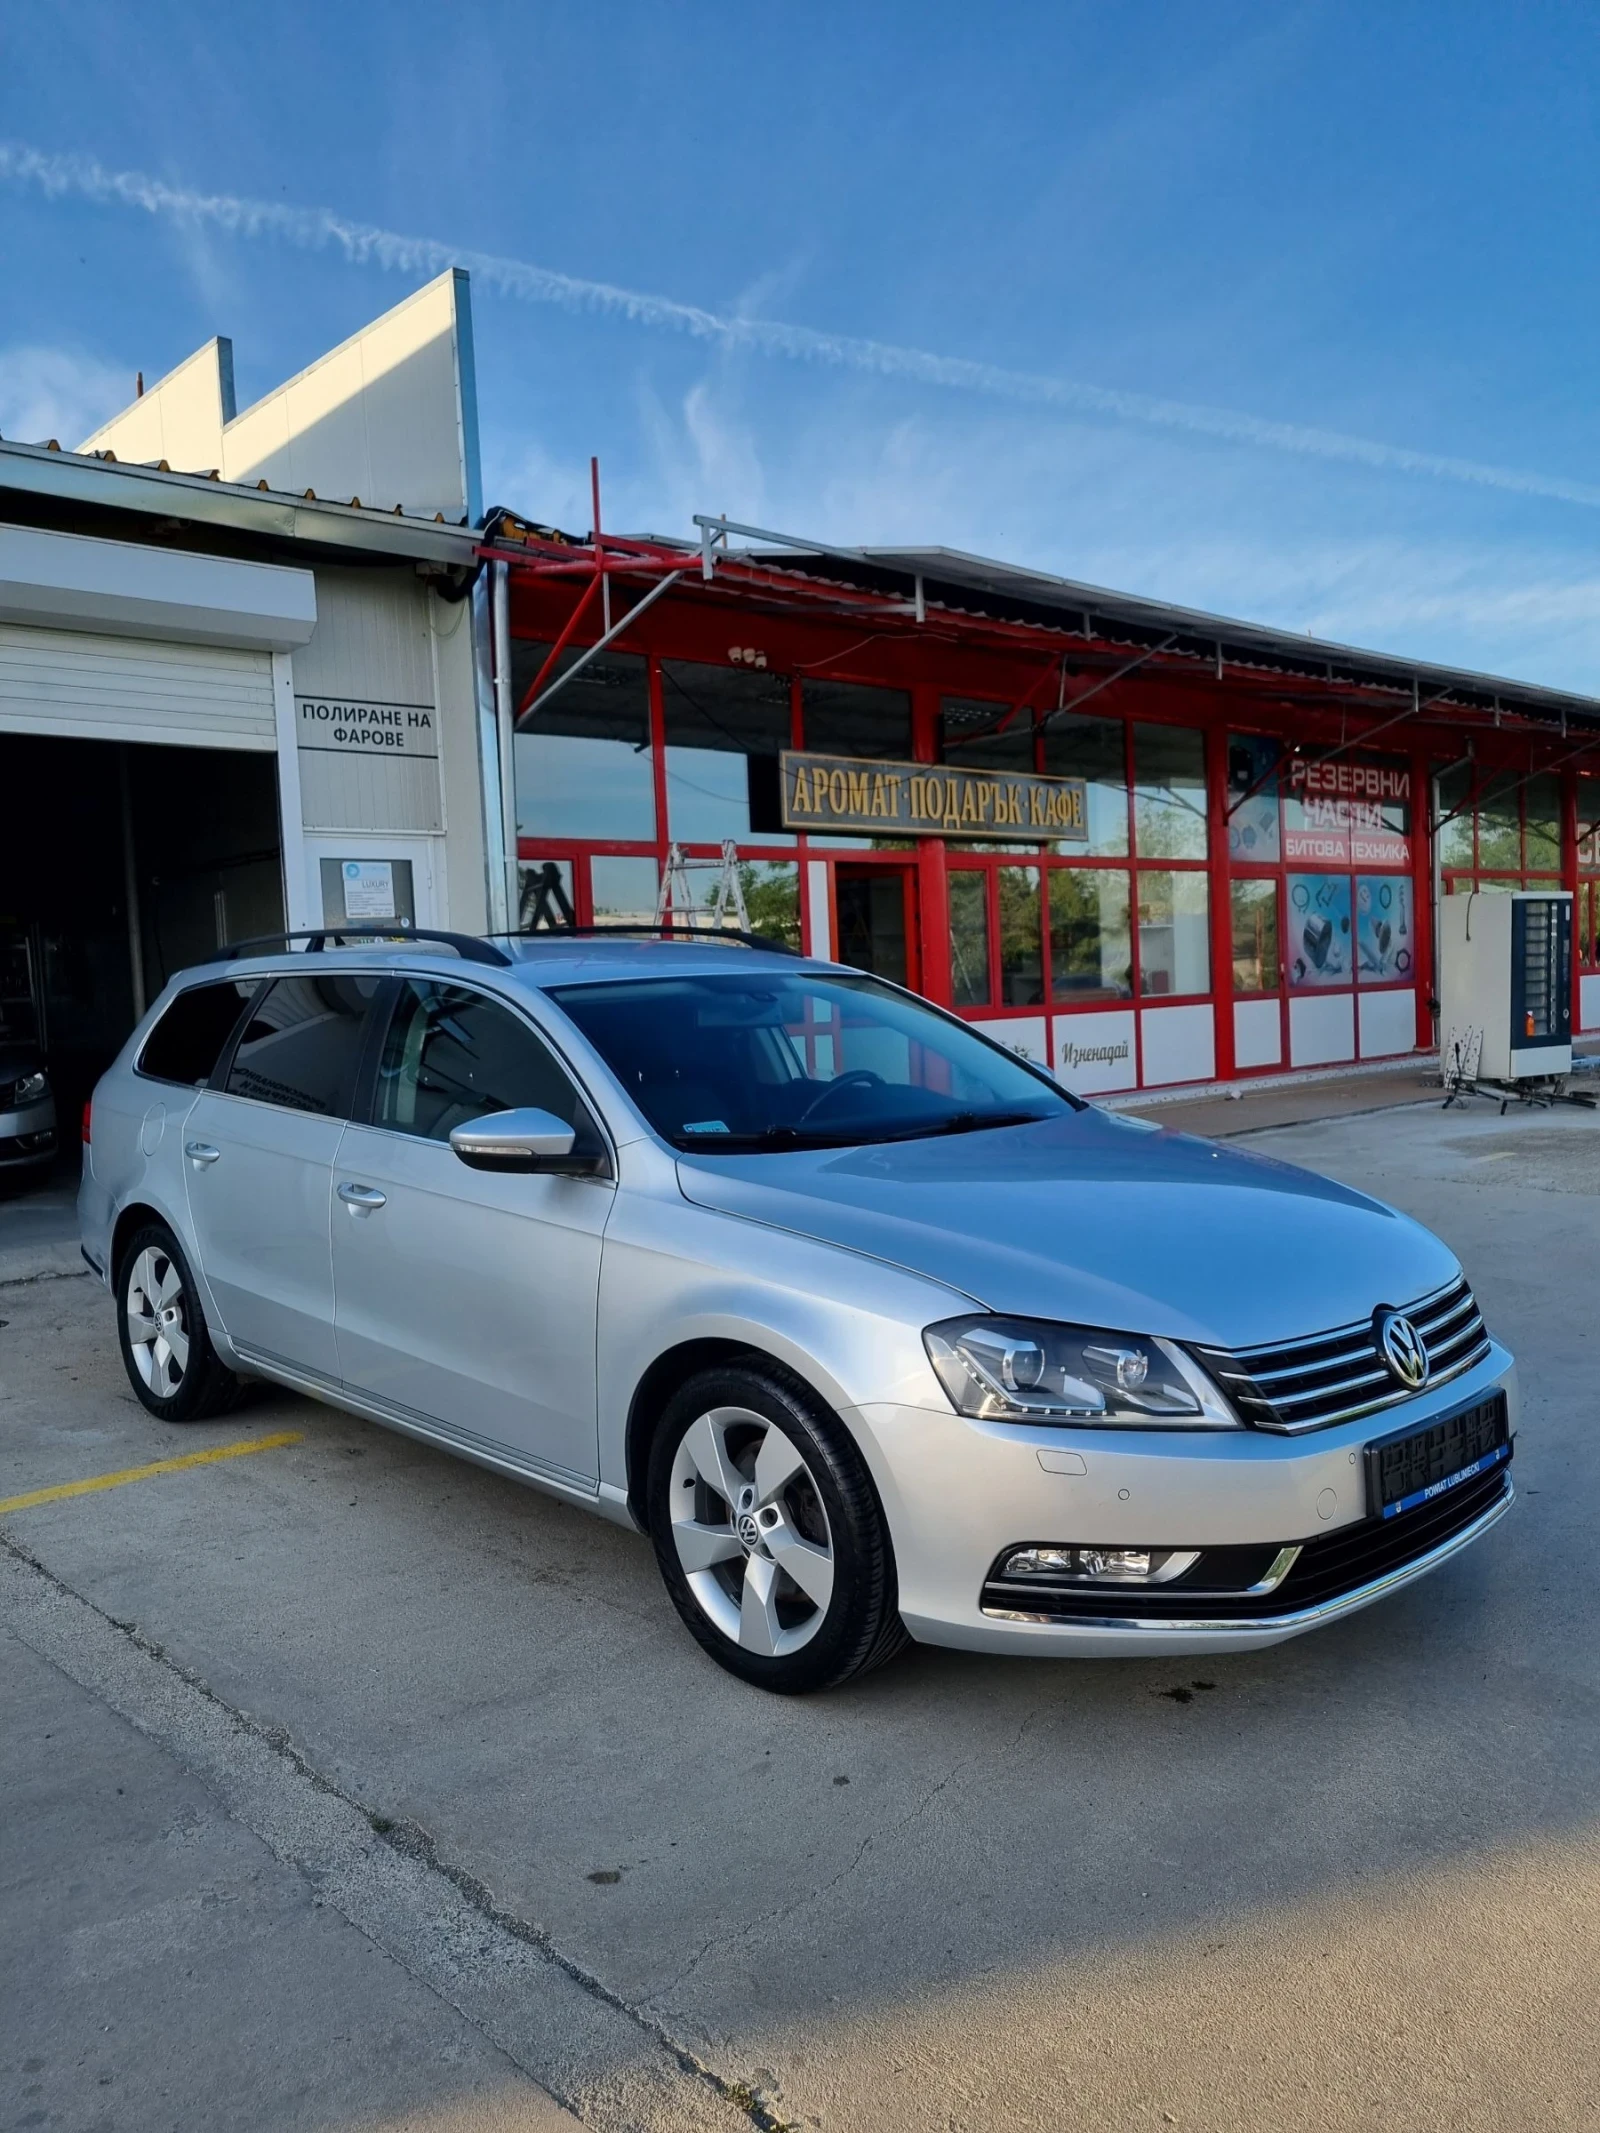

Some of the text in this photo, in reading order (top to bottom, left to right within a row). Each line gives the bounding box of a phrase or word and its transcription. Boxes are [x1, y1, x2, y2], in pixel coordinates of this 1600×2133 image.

[303, 704, 431, 728] ПОЛИРАНЕ НА
[333, 728, 404, 747] ФАРОВЕ
[1290, 760, 1410, 798] РЕЗЕРВНИ
[792, 767, 1085, 829] АРОМАТ ПОДАРЪК КАФЕ
[1303, 797, 1383, 829] ЧАСТИ
[1286, 838, 1410, 860] БИТОВА ТЕХНИКА
[362, 880, 389, 889] LUXURY
[1062, 1040, 1128, 1069] Изненадай
[1424, 1461, 1480, 1499] POWIAT LUBLINIECKI
